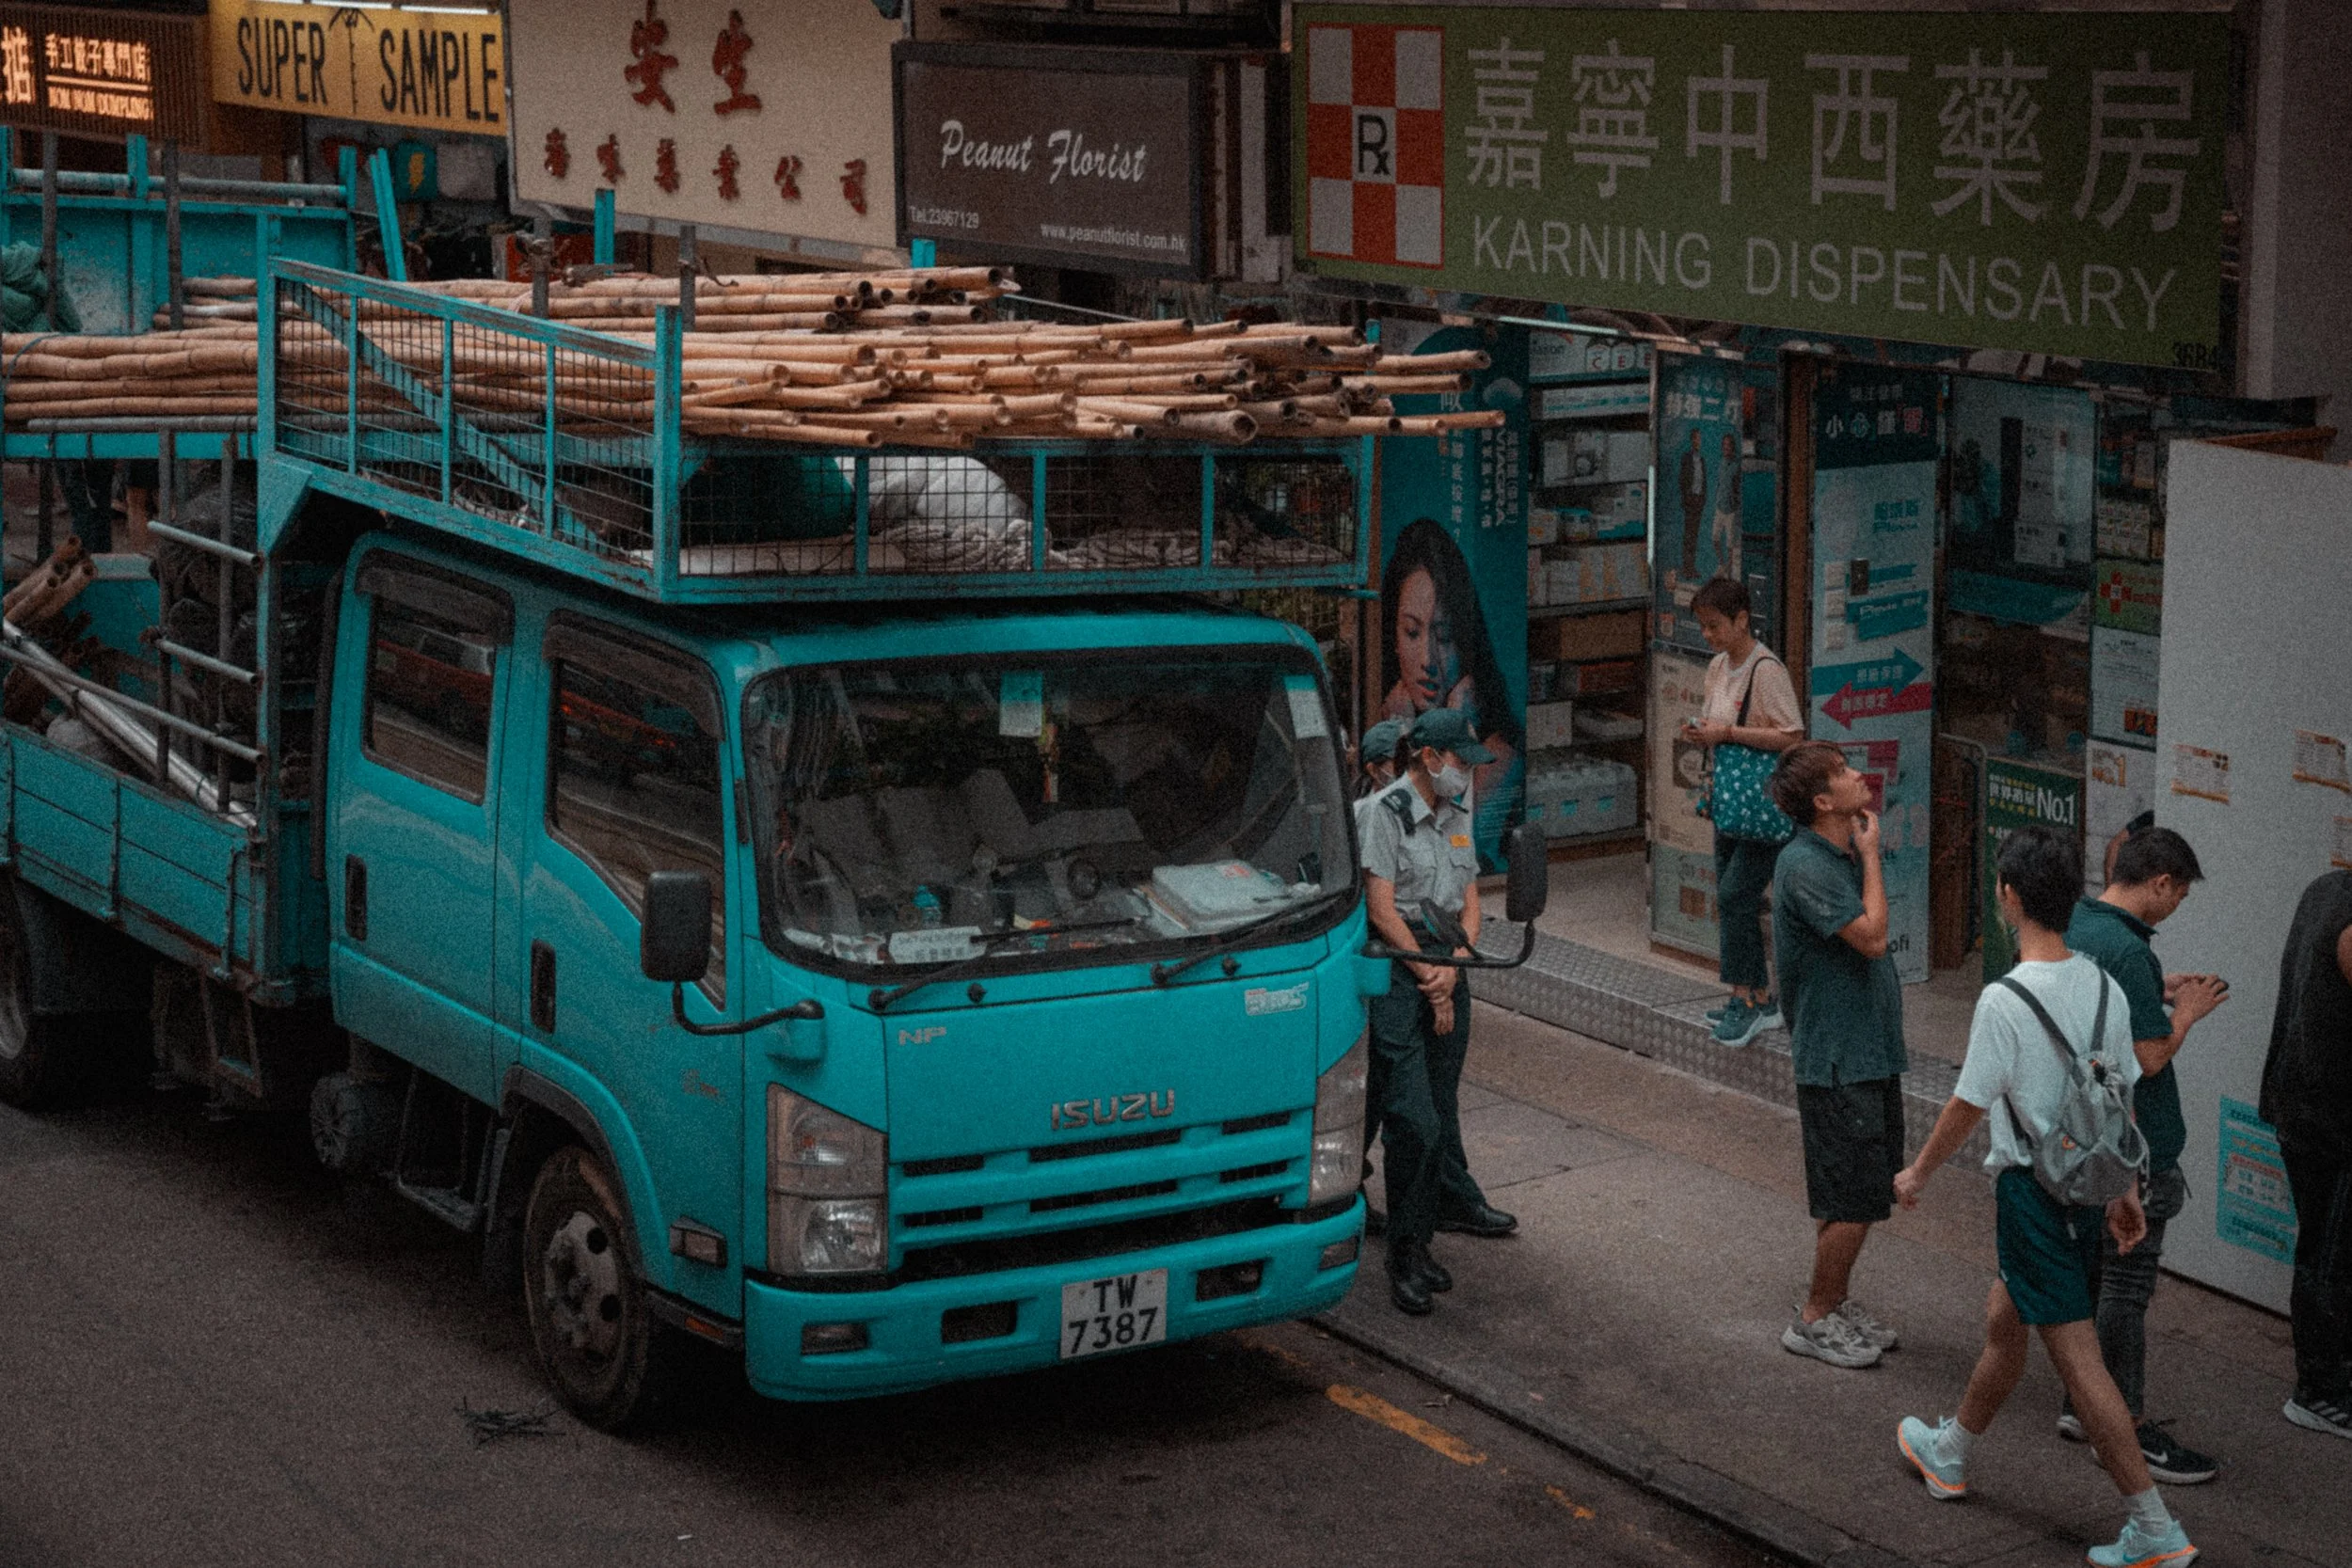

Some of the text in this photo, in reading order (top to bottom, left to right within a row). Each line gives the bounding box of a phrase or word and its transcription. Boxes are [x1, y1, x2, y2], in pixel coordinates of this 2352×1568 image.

[238, 17, 500, 123] SUPER SAMPLE
[941, 119, 1147, 184] Peanut Florist
[1040, 223, 1186, 255] www.peanutflorist.com.hk
[1473, 215, 2177, 332] KARNING DISPENSARY
[2037, 786, 2075, 825] No.1
[898, 1026, 946, 1046] NP
[1051, 1089, 1175, 1130] ISUZU
[1093, 1275, 1137, 1312] TW
[1068, 1306, 1158, 1354] 7387
